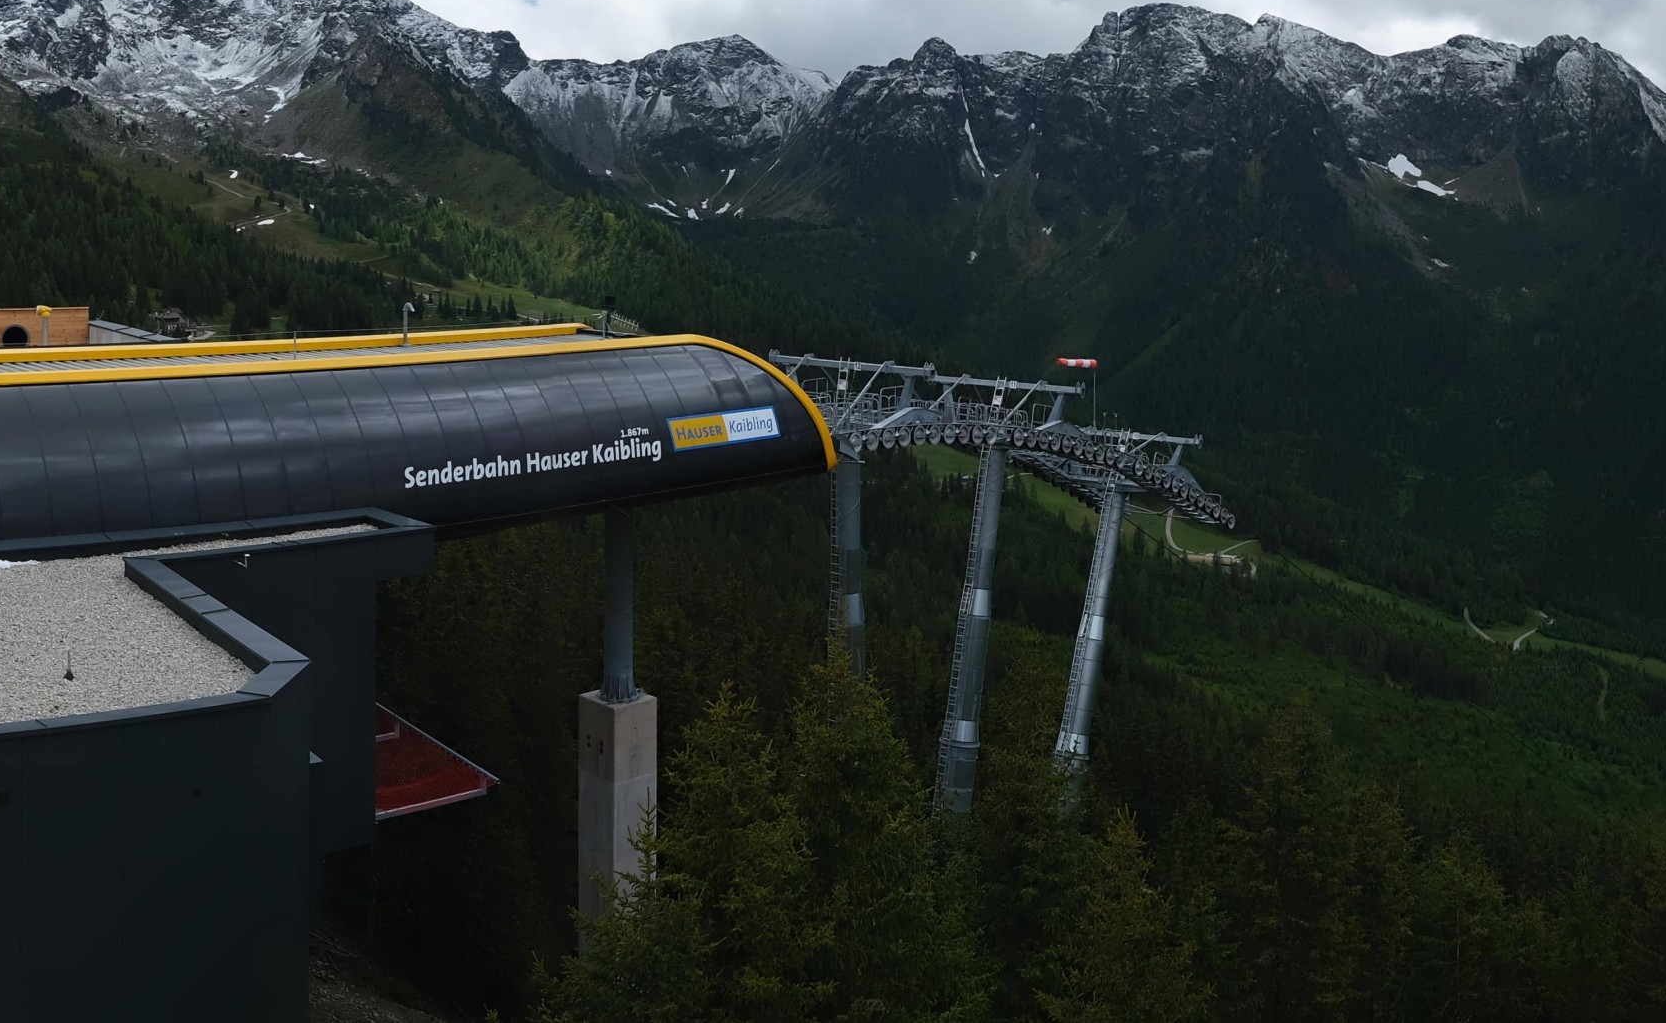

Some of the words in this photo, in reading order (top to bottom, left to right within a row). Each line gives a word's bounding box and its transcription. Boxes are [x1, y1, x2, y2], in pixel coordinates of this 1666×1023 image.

[620, 427, 649, 438] 1.867m
[676, 424, 724, 442] HAUSER
[729, 416, 774, 434] Kaibling
[404, 454, 521, 488] Senderbahn
[526, 448, 588, 474] Hauser
[592, 437, 662, 463] Kaibling
